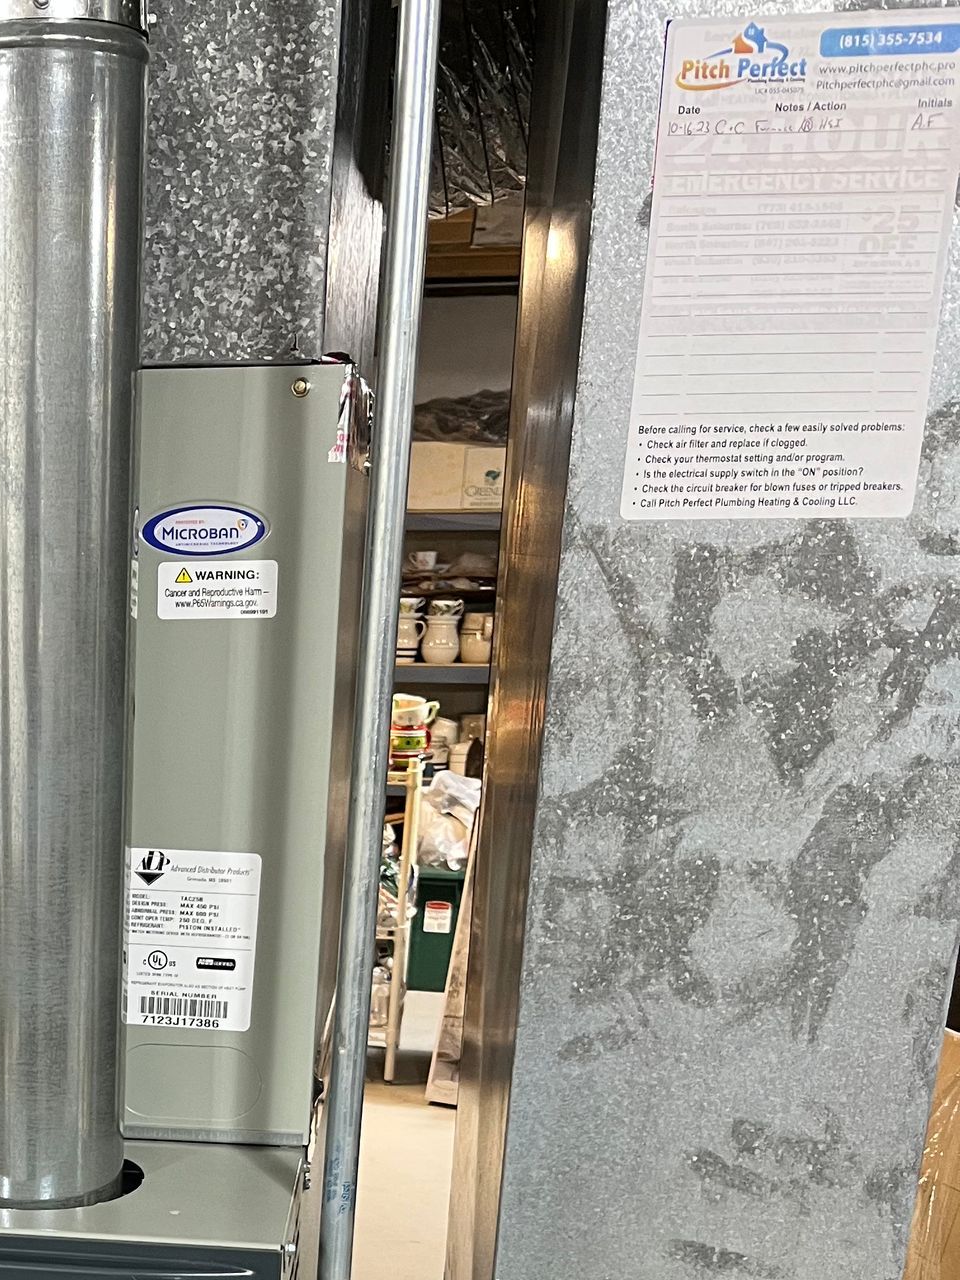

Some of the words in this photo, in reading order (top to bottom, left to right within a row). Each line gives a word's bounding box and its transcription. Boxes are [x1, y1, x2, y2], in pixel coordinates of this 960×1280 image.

[840, 33, 875, 49] (815)
[878, 31, 942, 46] 355-7534
[681, 58, 730, 79] Pitch
[737, 57, 807, 78] Perfect
[820, 61, 955, 75] www.pitchperfectphc.pro
[816, 77, 955, 91] Pitchperfectphc@gmail.com
[678, 106, 700, 115] Date
[775, 102, 804, 112] Notes
[807, 102, 811, 111] /
[813, 101, 846, 111] Action
[918, 98, 952, 108] Initials
[638, 425, 666, 435] Before
[668, 425, 697, 435] calling
[700, 424, 712, 433] for
[713, 424, 746, 434] service,
[749, 424, 774, 433] check
[784, 423, 800, 432] few
[802, 423, 827, 433] easily
[830, 422, 859, 432] solved
[861, 422, 905, 433] problems:
[647, 440, 673, 449] Check
[675, 440, 687, 448] air
[689, 439, 709, 448] filter
[711, 439, 727, 448] and
[729, 439, 760, 449] replace
[763, 438, 769, 447] if
[771, 438, 807, 449] clogged.
[645, 455, 672, 463] Check
[674, 456, 694, 465] your
[696, 454, 741, 463] thermostat
[744, 454, 773, 464] setting
[776, 453, 804, 462] and/or
[806, 453, 845, 463] program.
[643, 470, 651, 478] Is
[653, 470, 666, 478] the
[669, 469, 707, 478] electrical
[710, 469, 738, 479] supply
[741, 468, 768, 477] switch
[771, 468, 779, 477] in
[781, 468, 795, 477] the
[822, 467, 864, 477] position?
[642, 484, 668, 493] Check
[670, 484, 683, 493] the
[686, 484, 713, 492] circuit
[715, 483, 747, 492] breaker
[750, 483, 762, 491] for
[764, 482, 790, 491] blown
[792, 482, 816, 491] fuses
[830, 482, 860, 492] tripped
[863, 481, 903, 491] breakers.
[640, 499, 656, 507] Call
[658, 498, 680, 507] Pitch
[682, 498, 712, 507] Perfect
[715, 498, 755, 508] Plumbing
[758, 497, 790, 508] Heating
[793, 497, 799, 506] &
[802, 497, 836, 507] Cooling
[838, 496, 858, 506] LLC.
[162, 526, 239, 541] MICROBAN
[195, 570, 260, 581] WARNING:
[164, 588, 187, 598] Cancer
[188, 588, 200, 597] and
[202, 587, 243, 600] Reproductive
[245, 587, 262, 596] Harm
[171, 865, 196, 873] Advanced
[151, 990, 179, 998] SERIAL
[182, 992, 217, 1000] NUMBER
[142, 1015, 220, 1029] 7123J17386
